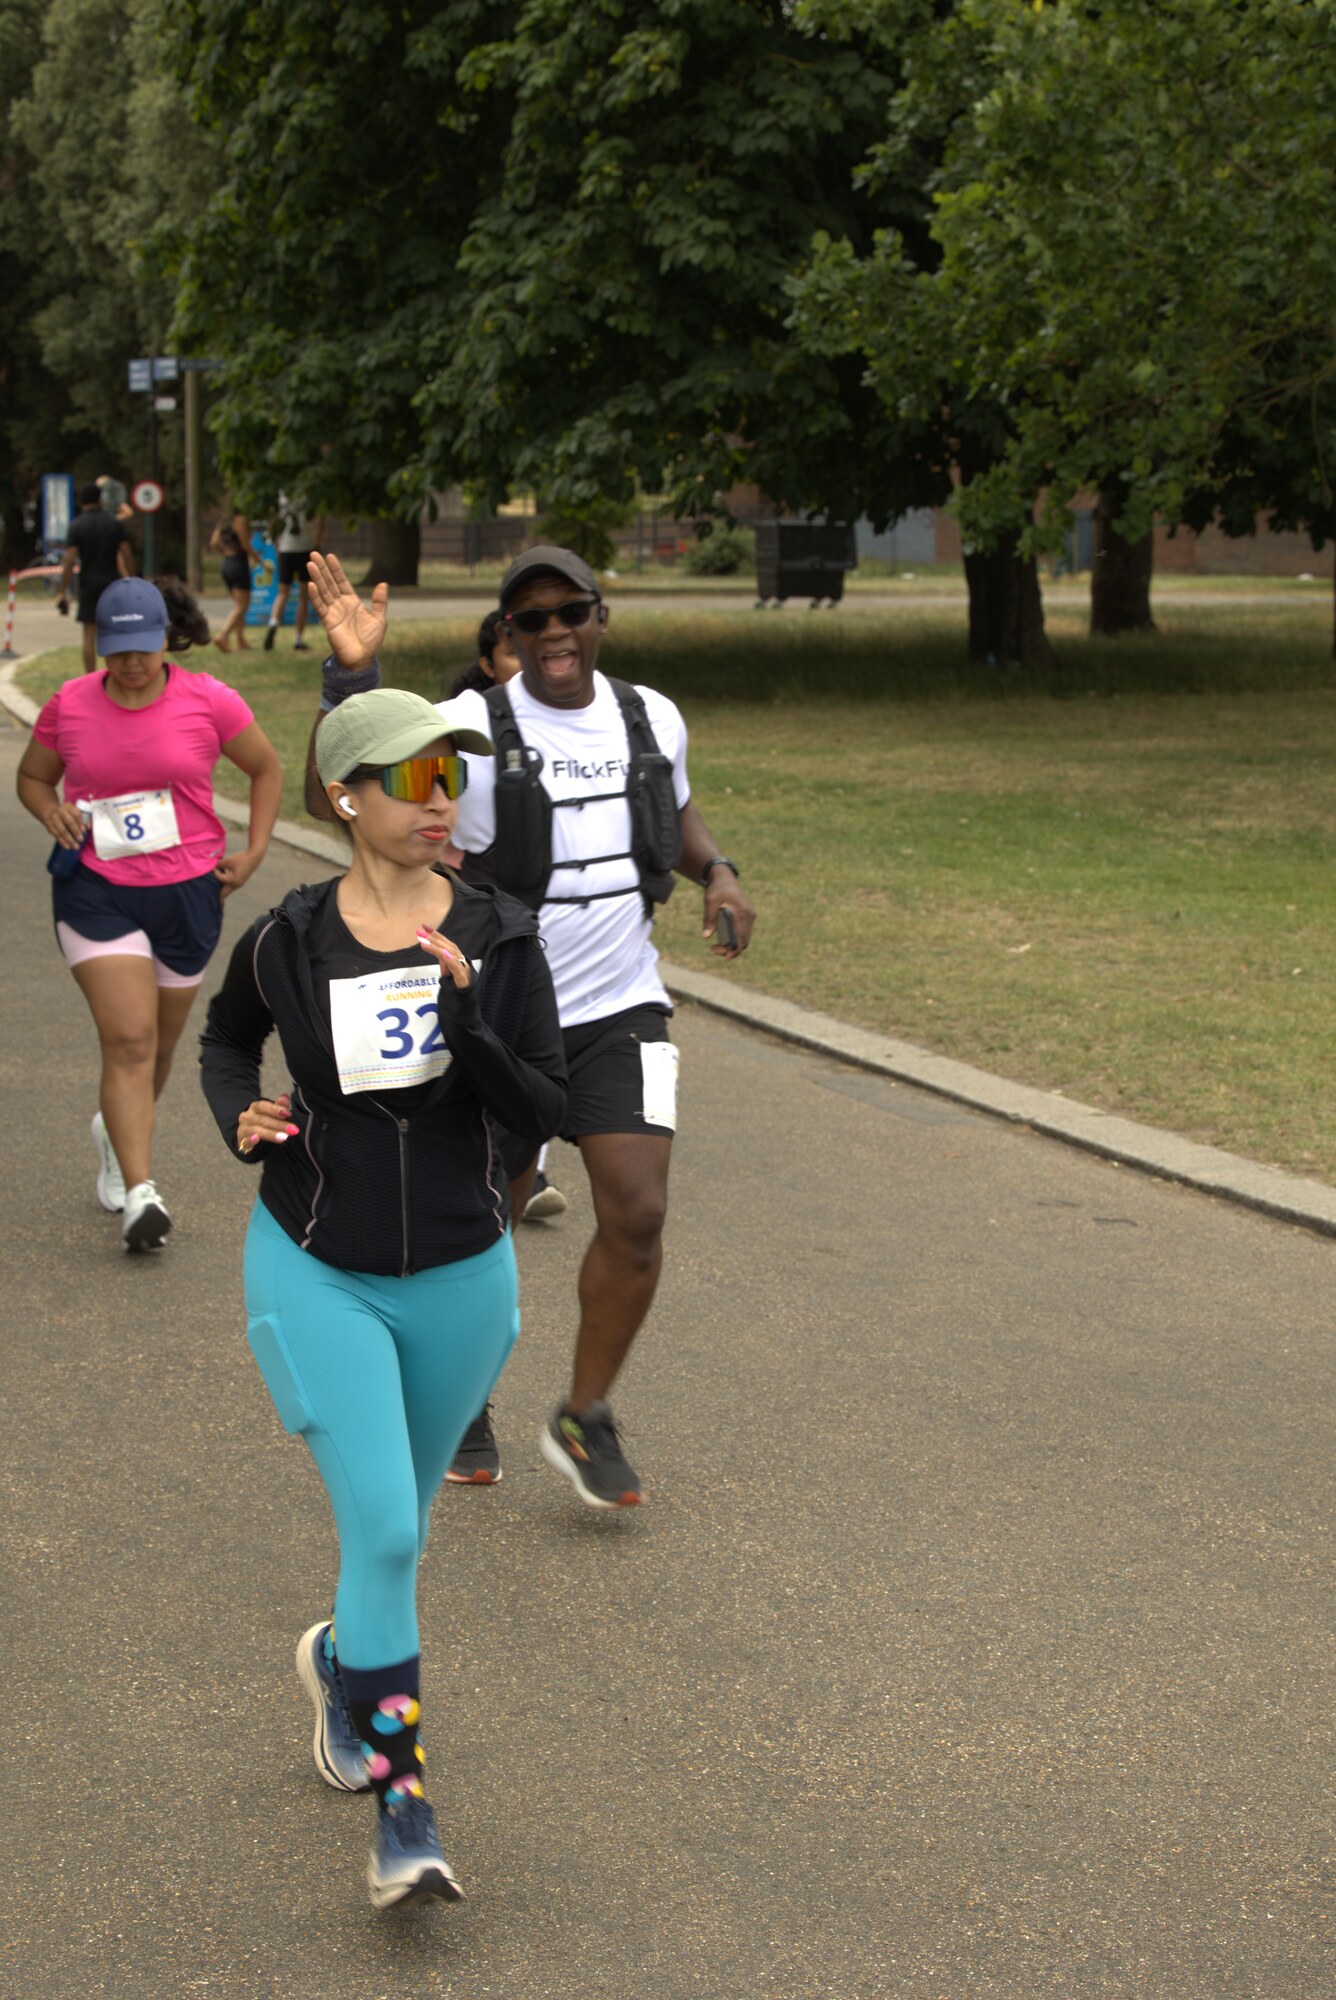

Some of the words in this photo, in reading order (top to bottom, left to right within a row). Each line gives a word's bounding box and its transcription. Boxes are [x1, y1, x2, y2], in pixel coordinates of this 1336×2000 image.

[124, 813, 145, 841] 8
[379, 977, 437, 991] AFFORDABLE
[385, 990, 433, 1002] RUNNING
[376, 1003, 449, 1059] 32
